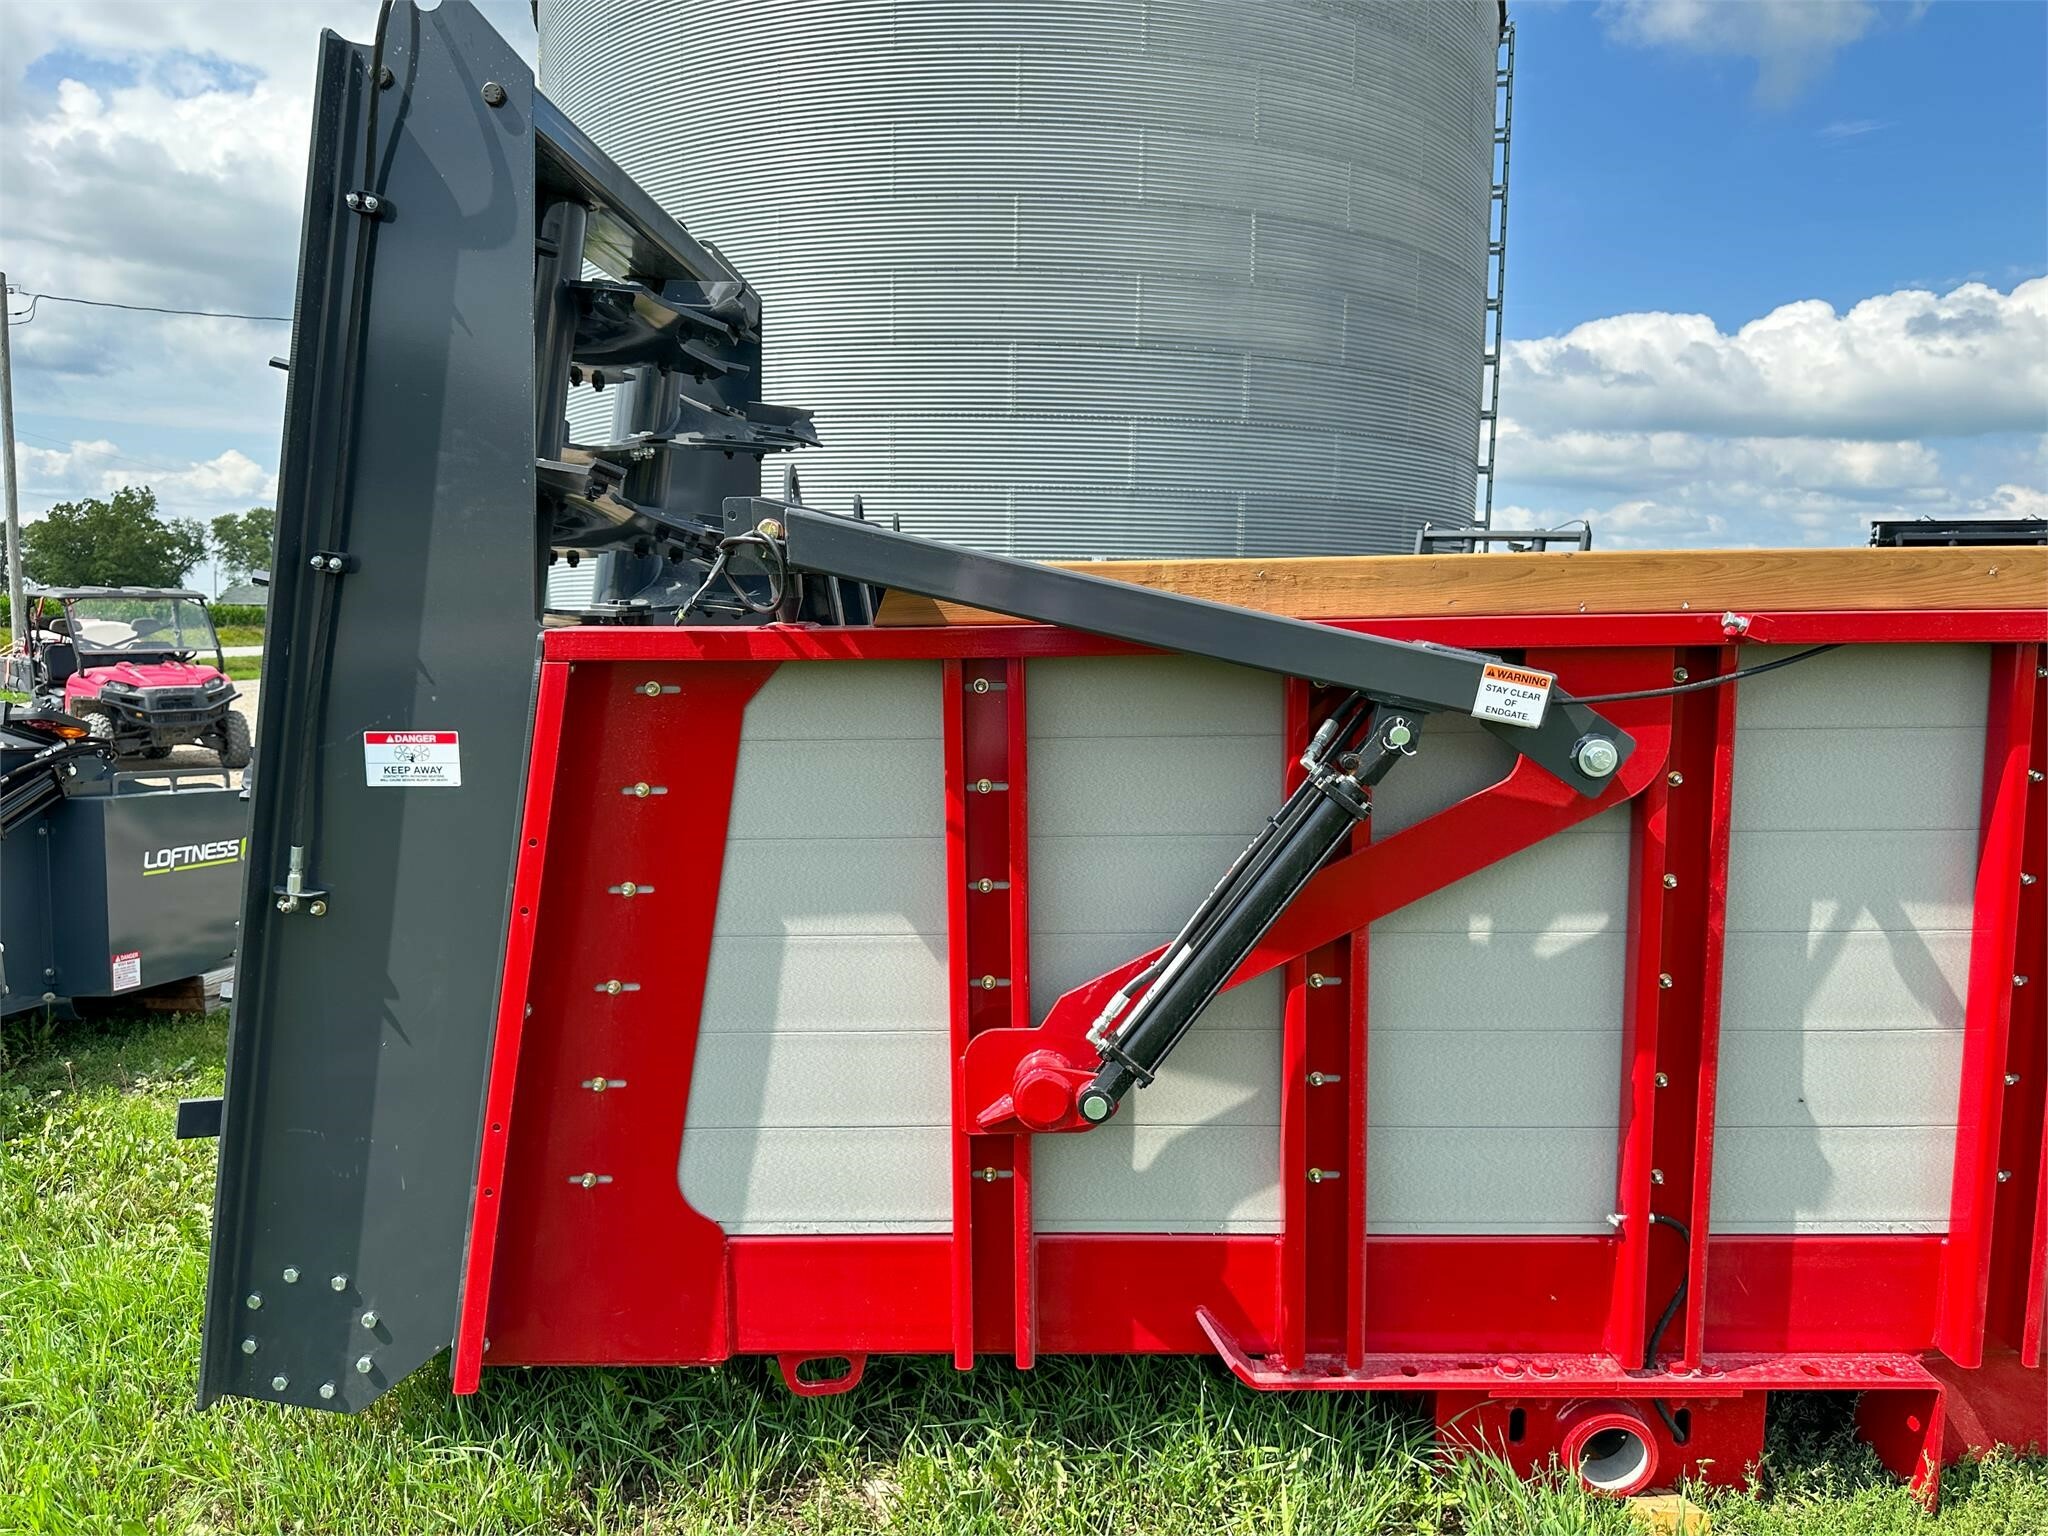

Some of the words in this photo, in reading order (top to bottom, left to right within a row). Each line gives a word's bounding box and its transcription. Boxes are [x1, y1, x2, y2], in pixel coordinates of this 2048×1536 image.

[1498, 670, 1547, 687] WARNING
[1486, 684, 1509, 694] STAY
[1510, 689, 1541, 701] CLEAR
[1504, 698, 1518, 707] OF
[1485, 705, 1530, 721] ENDGATE.
[394, 734, 437, 743] DANGER
[384, 766, 411, 774] KEEP
[414, 766, 443, 774] AWAY
[144, 839, 240, 869] LOFTNESS
[120, 952, 139, 961] DANGER
